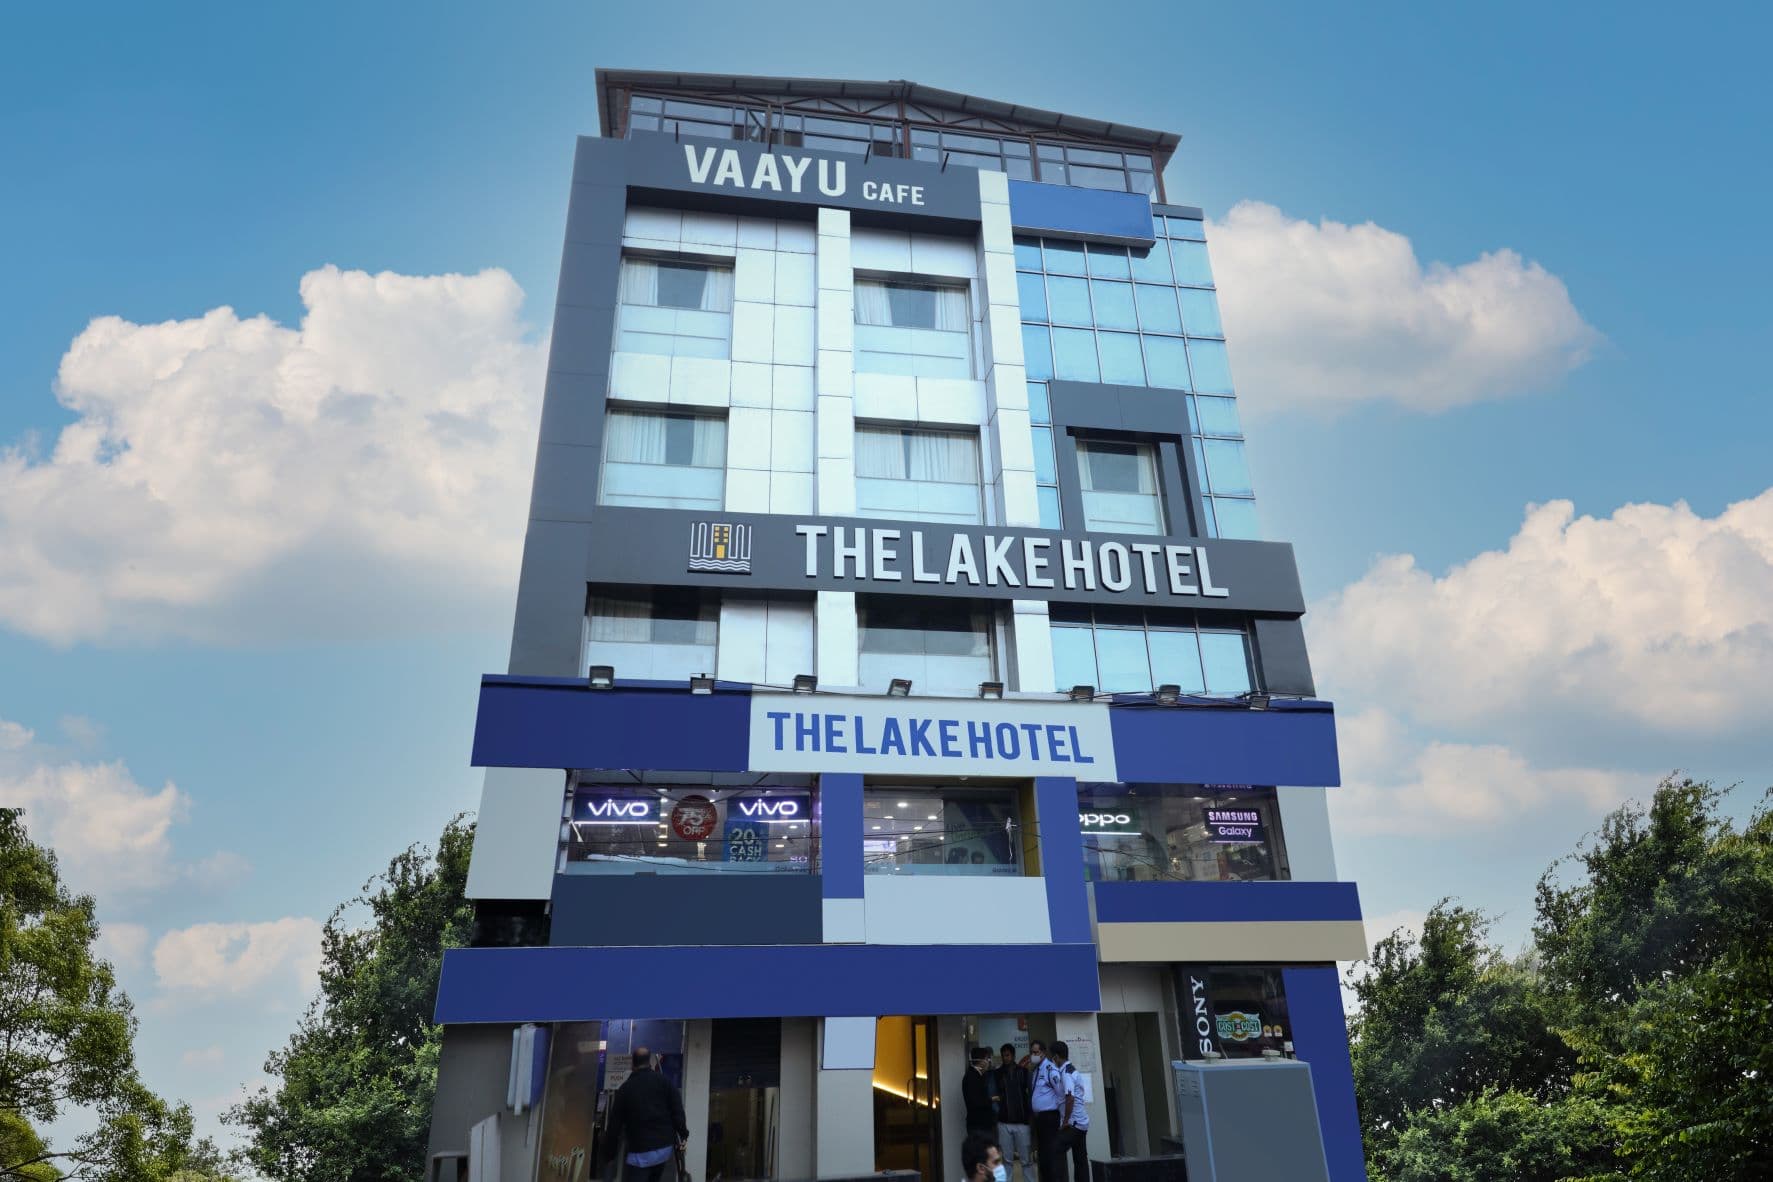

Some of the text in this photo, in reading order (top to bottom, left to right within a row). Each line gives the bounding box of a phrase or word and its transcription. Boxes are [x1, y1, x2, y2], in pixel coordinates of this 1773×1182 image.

[684, 144, 925, 206] VAAYU CAFE
[796, 524, 1229, 597] THE LAKE HOTEL
[767, 712, 1095, 764] THE LAKE HOTEL
[588, 798, 649, 816] vivo
[739, 798, 799, 816] vivo
[1208, 811, 1258, 821] SAMSUNG
[1218, 826, 1252, 838] Galaxy
[729, 846, 762, 857] CASH
[1190, 975, 1213, 1055] SONY
